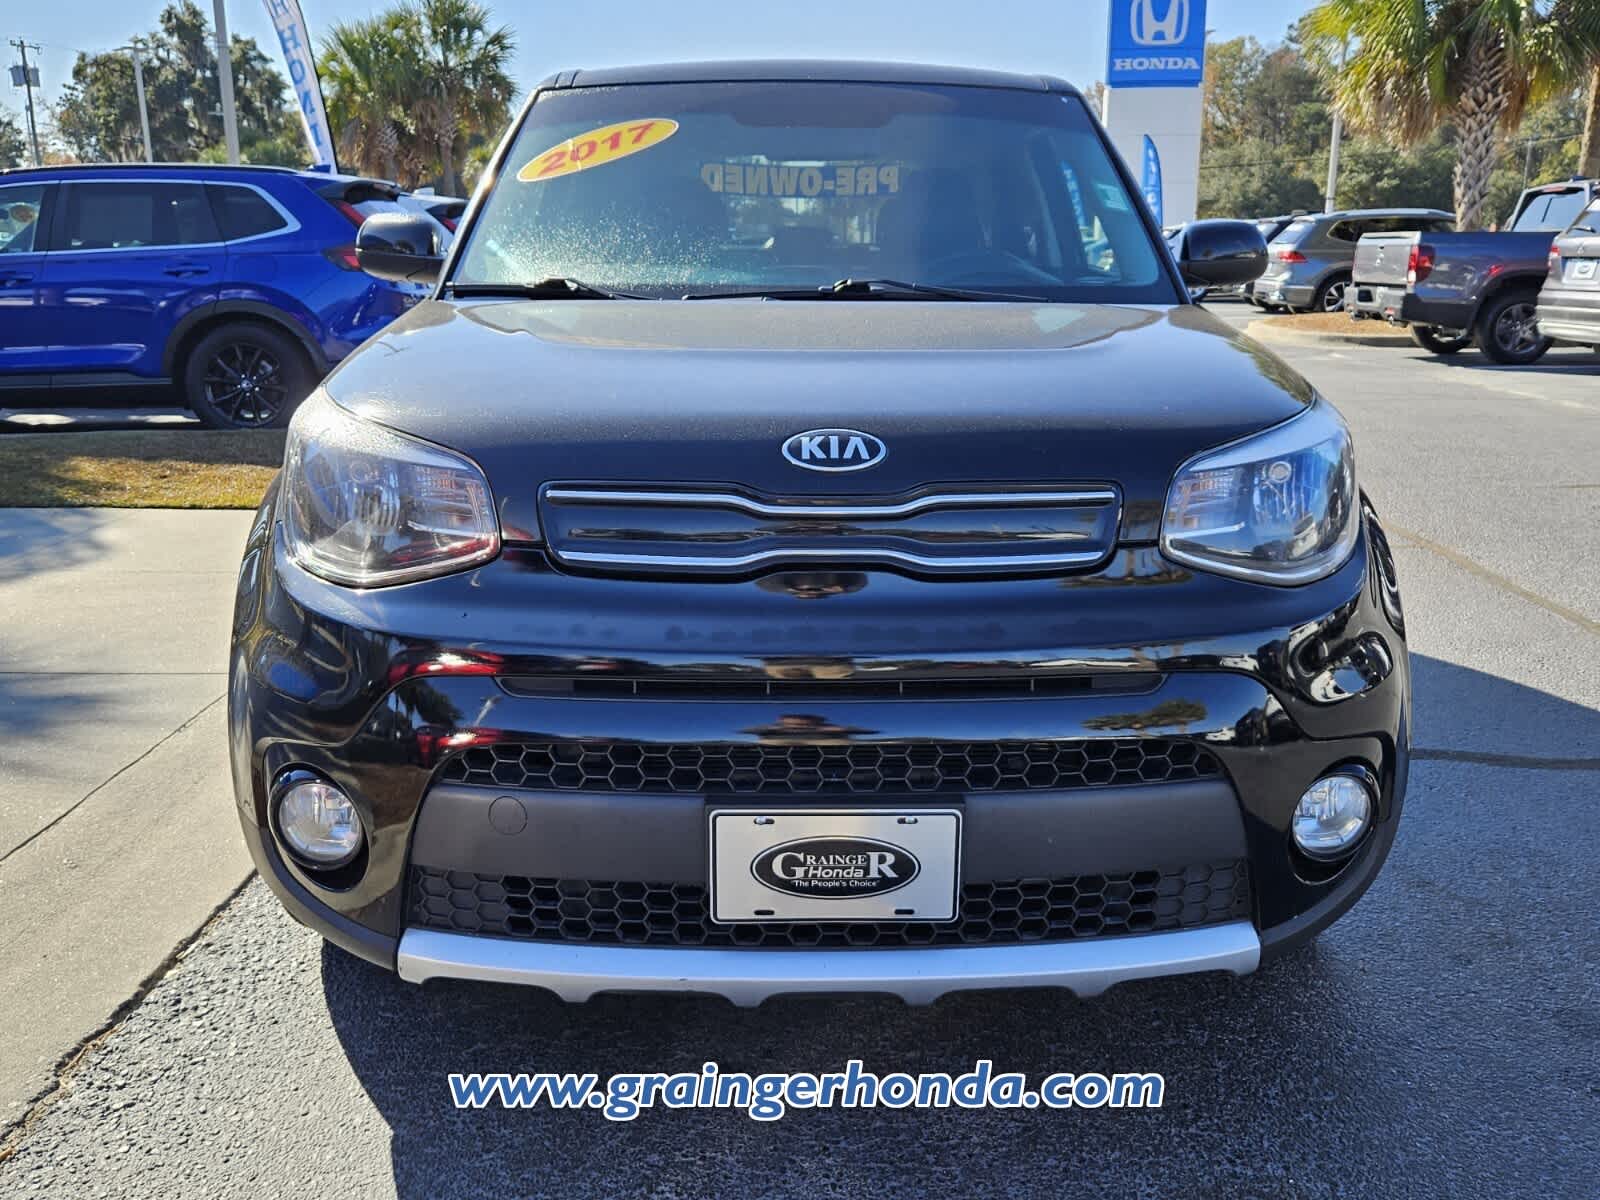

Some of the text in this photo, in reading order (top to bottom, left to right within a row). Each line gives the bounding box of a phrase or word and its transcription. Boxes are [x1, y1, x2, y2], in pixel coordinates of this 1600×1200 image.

[1113, 57, 1200, 71] HONDA
[538, 121, 655, 177] 2017
[799, 435, 871, 460] KIA
[771, 851, 898, 880] GRAINGER
[808, 866, 865, 879] Honda
[811, 880, 848, 889] People's
